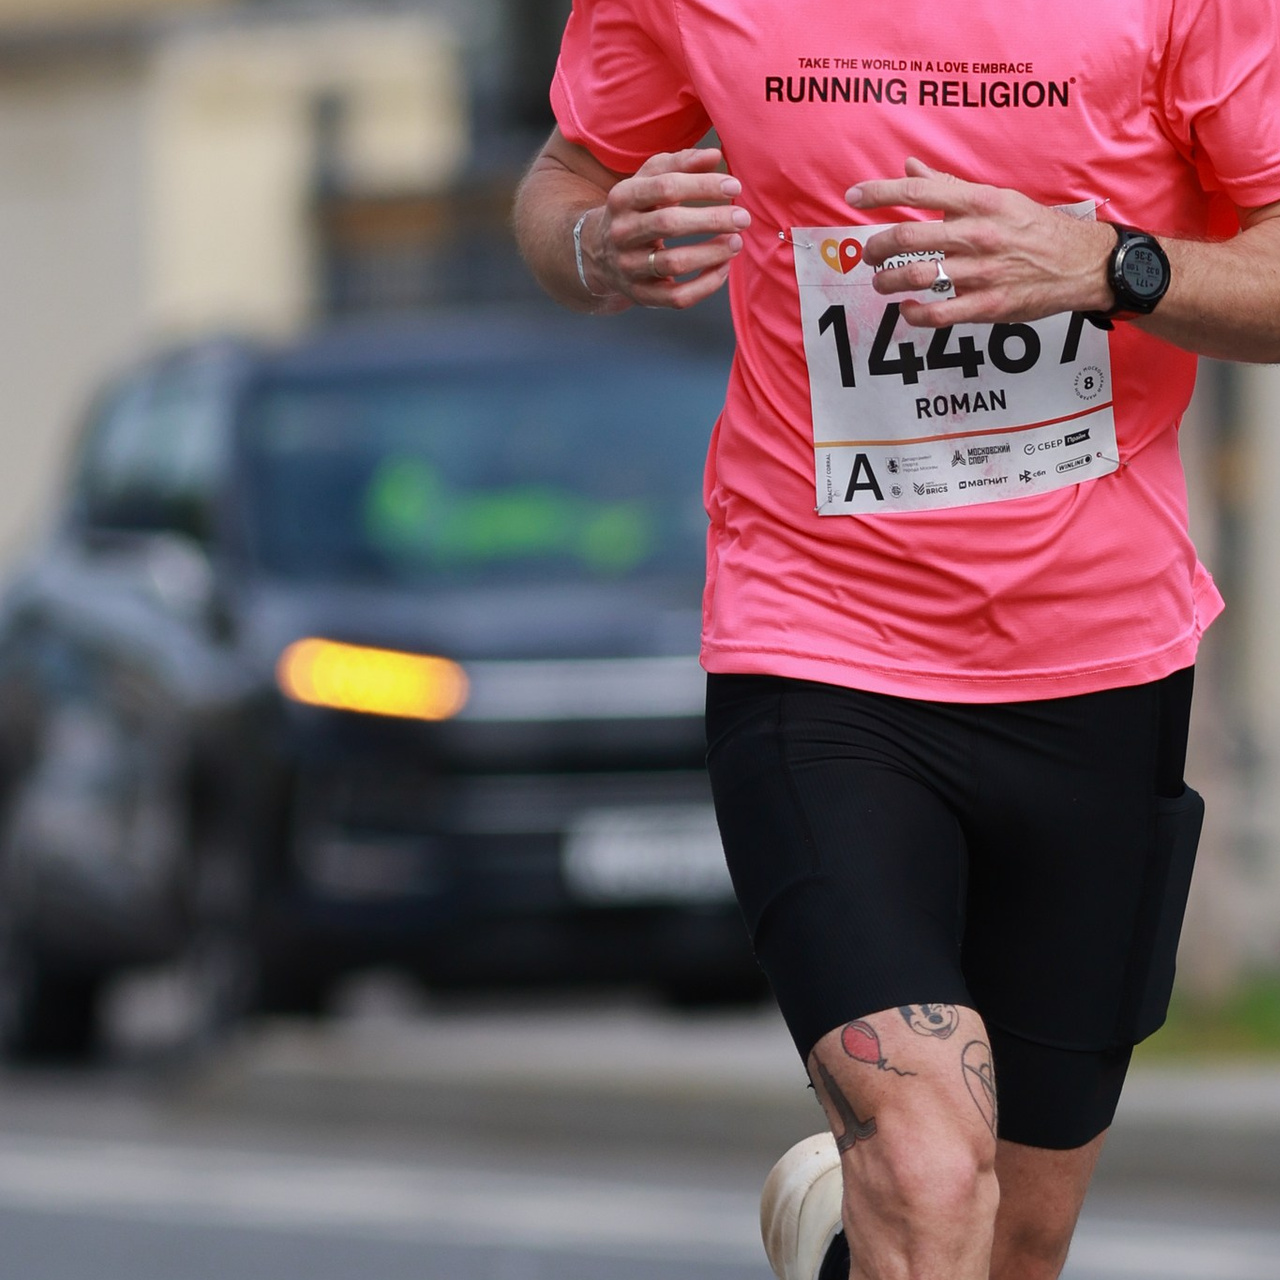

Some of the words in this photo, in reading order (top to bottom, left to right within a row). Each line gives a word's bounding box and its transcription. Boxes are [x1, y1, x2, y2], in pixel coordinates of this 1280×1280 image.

[798, 57, 830, 69] TAKE
[834, 58, 858, 69] THE
[861, 60, 907, 71] WORLD
[910, 61, 922, 71] IN
[925, 62, 934, 72] A
[937, 61, 968, 73] LOVE
[972, 62, 1033, 74] EMBRACE
[765, 76, 907, 105] RUNNING
[1083, 375, 1095, 390] 8
[916, 389, 1007, 419] ROMAN
[967, 442, 1011, 457] МОСКОВСКИЙ
[1037, 438, 1063, 451] СБЕР
[968, 455, 989, 466] СПОРТ
[1058, 457, 1084, 472] WINLINE
[844, 453, 885, 502] A
[926, 486, 948, 495] BRICS
